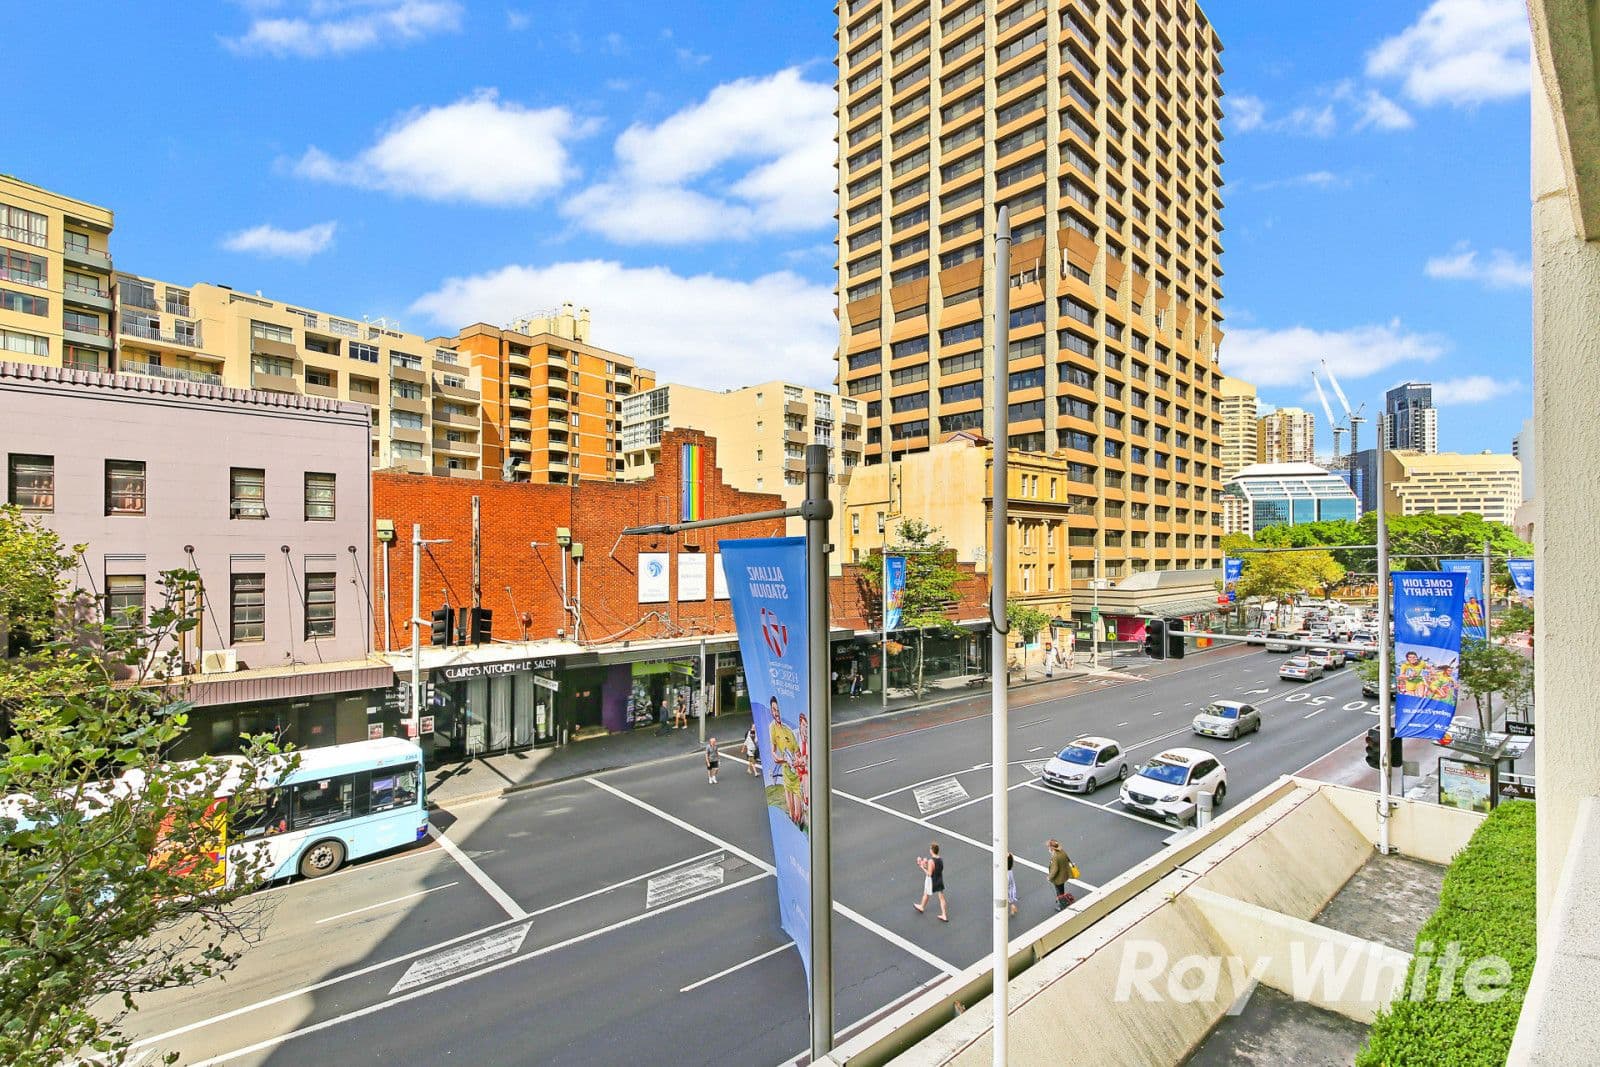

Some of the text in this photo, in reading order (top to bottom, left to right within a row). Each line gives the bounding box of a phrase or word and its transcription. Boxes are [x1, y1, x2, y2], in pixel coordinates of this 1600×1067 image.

[445, 666, 481, 679] CLAIRE'S
[482, 663, 515, 675] KITCHEN
[533, 658, 557, 670] SALON
